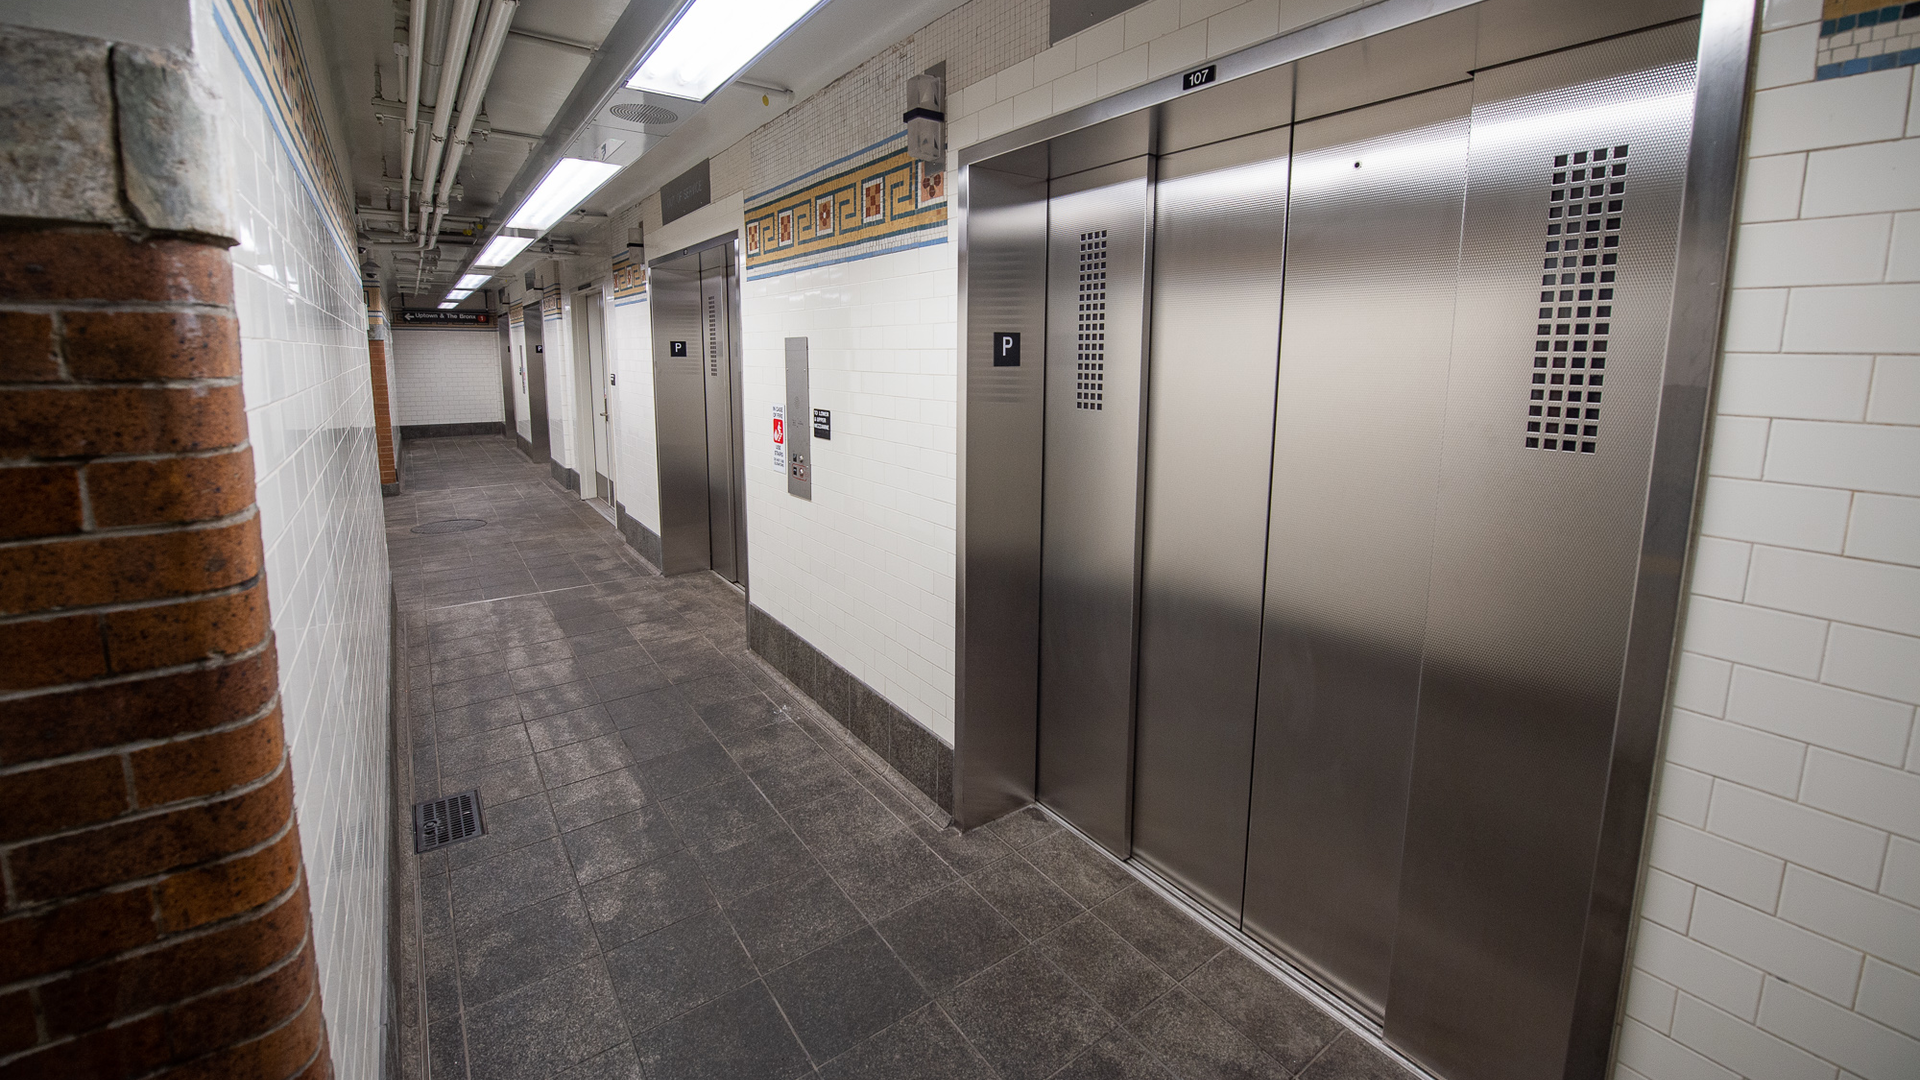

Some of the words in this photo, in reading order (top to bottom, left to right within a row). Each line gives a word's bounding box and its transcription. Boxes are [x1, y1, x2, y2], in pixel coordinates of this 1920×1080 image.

[1189, 69, 1209, 86] 107
[675, 342, 682, 352] P
[1002, 336, 1013, 356] P
